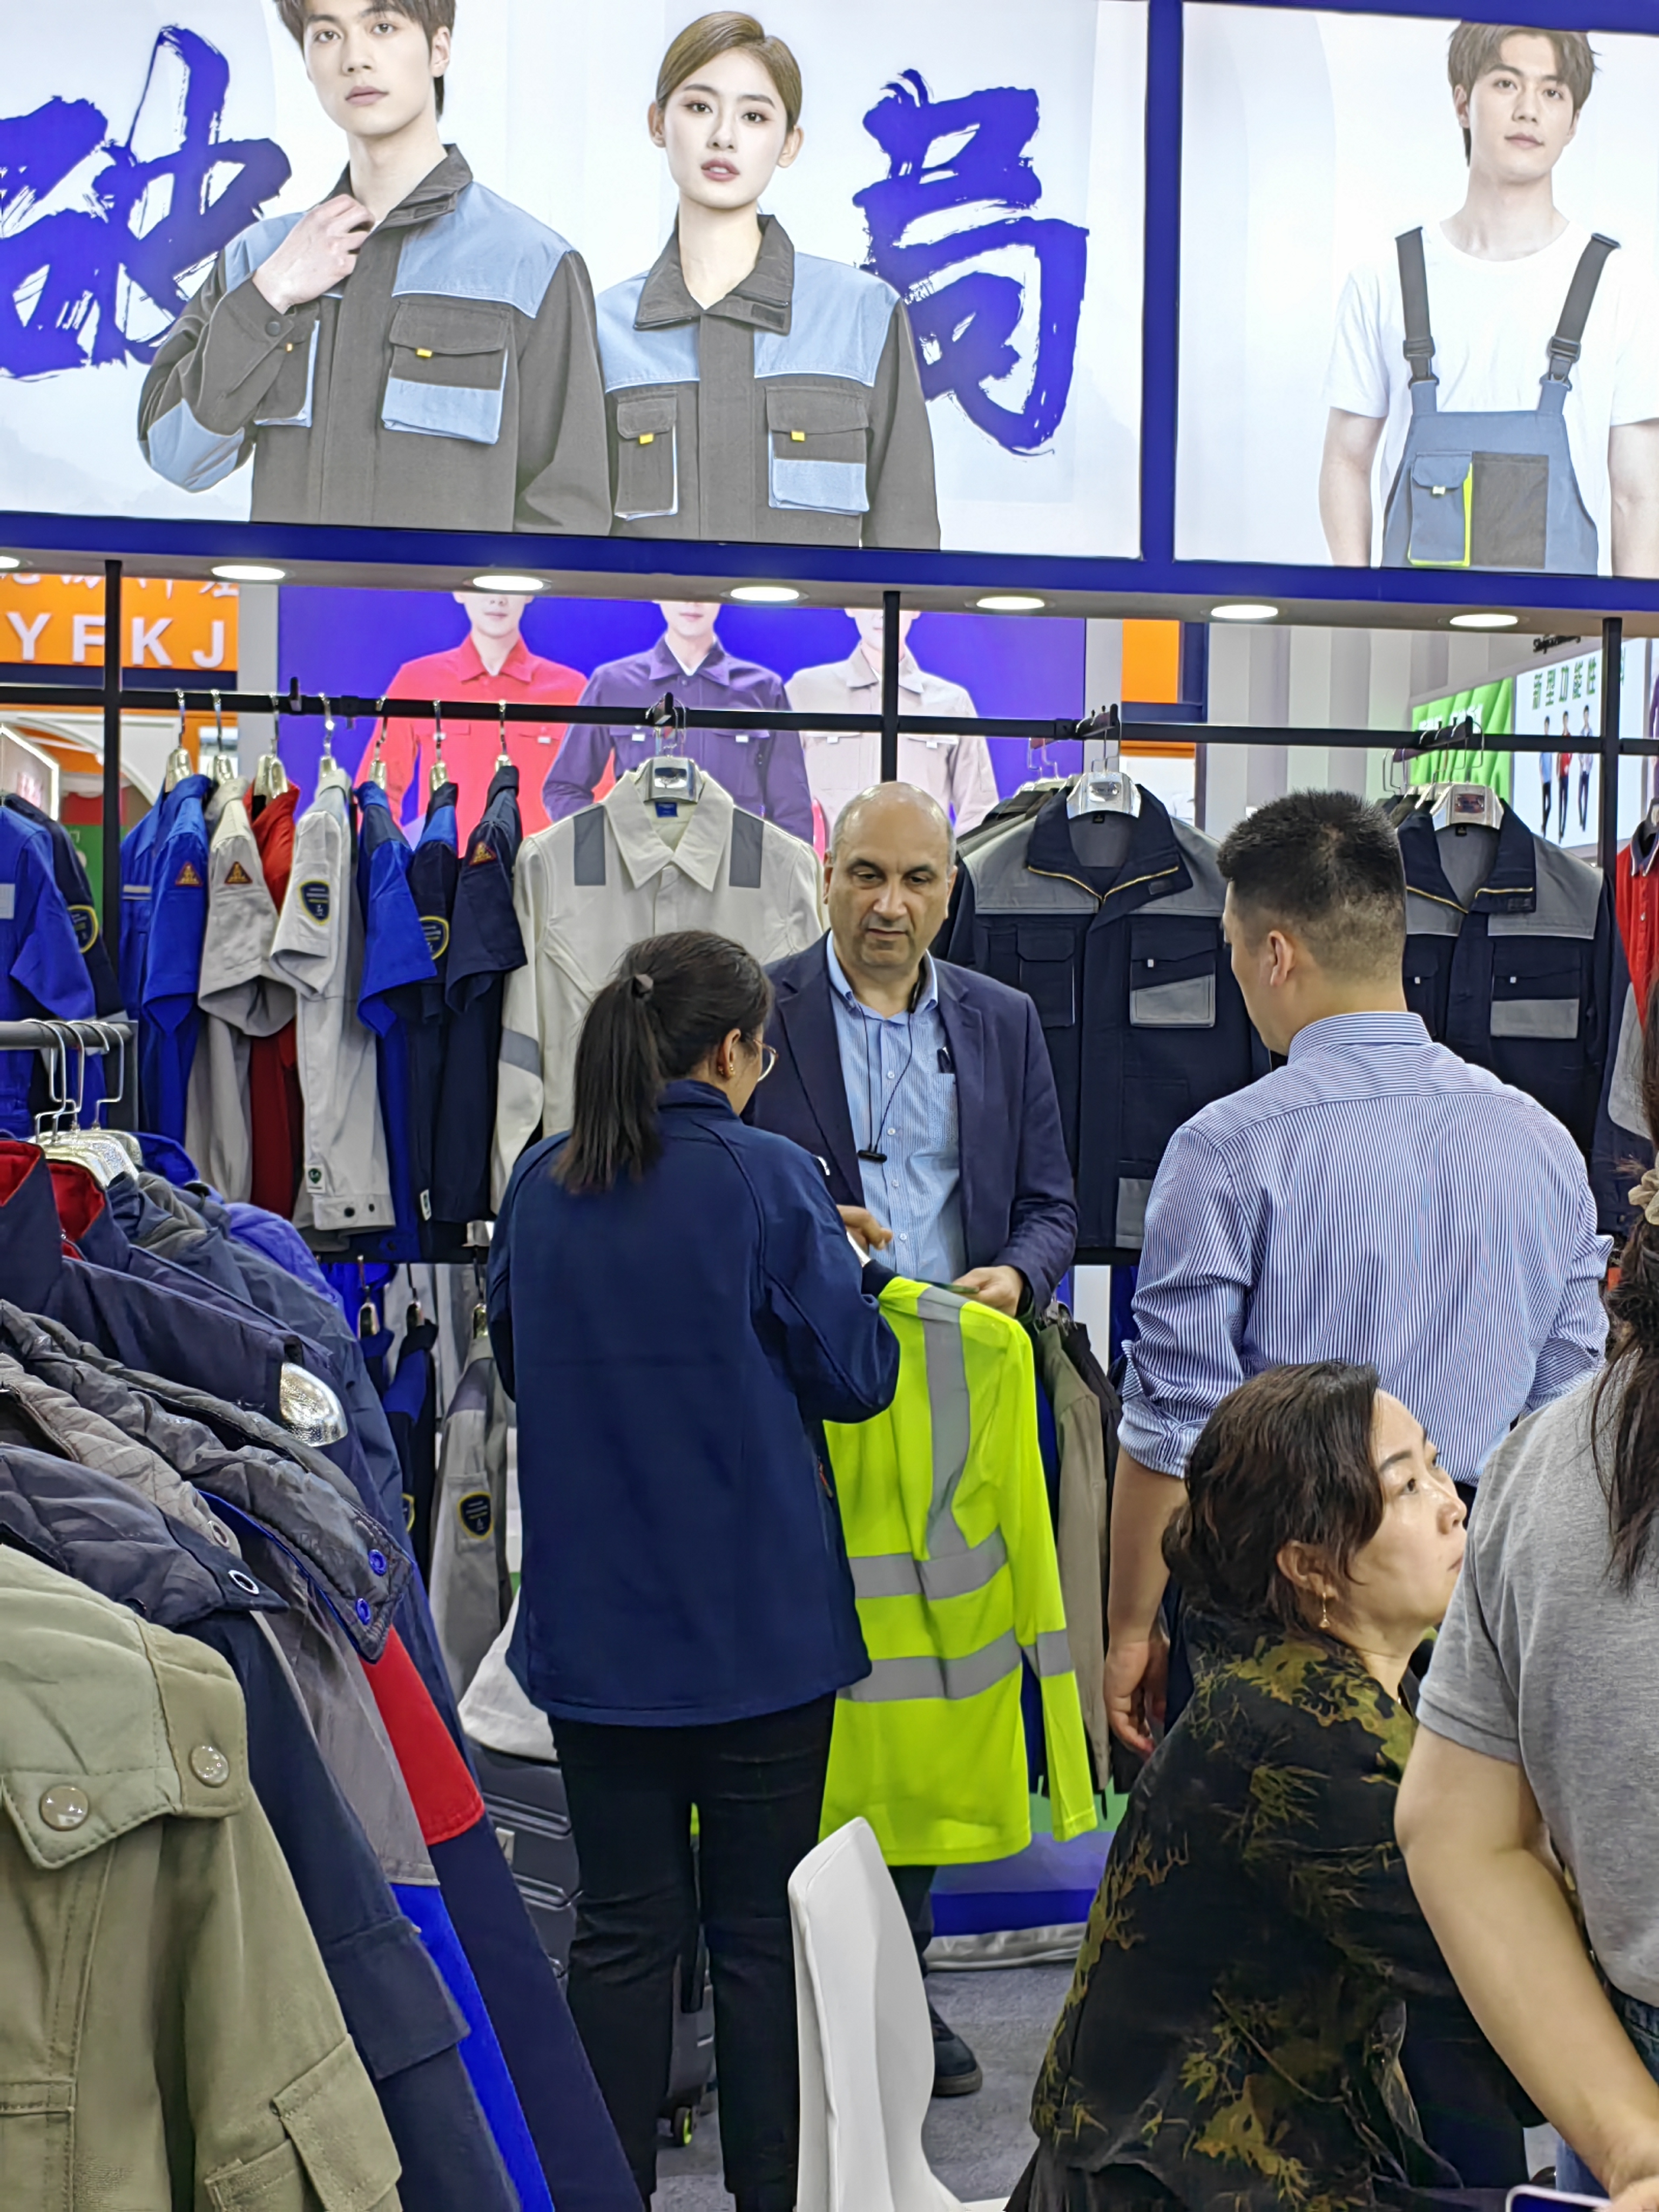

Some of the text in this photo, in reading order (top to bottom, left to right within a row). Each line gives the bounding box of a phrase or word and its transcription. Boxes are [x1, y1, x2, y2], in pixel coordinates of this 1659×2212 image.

[852, 69, 1090, 462] 局
[6, 611, 226, 669] YFKJ
[1532, 646, 1626, 711] 新型功能性
